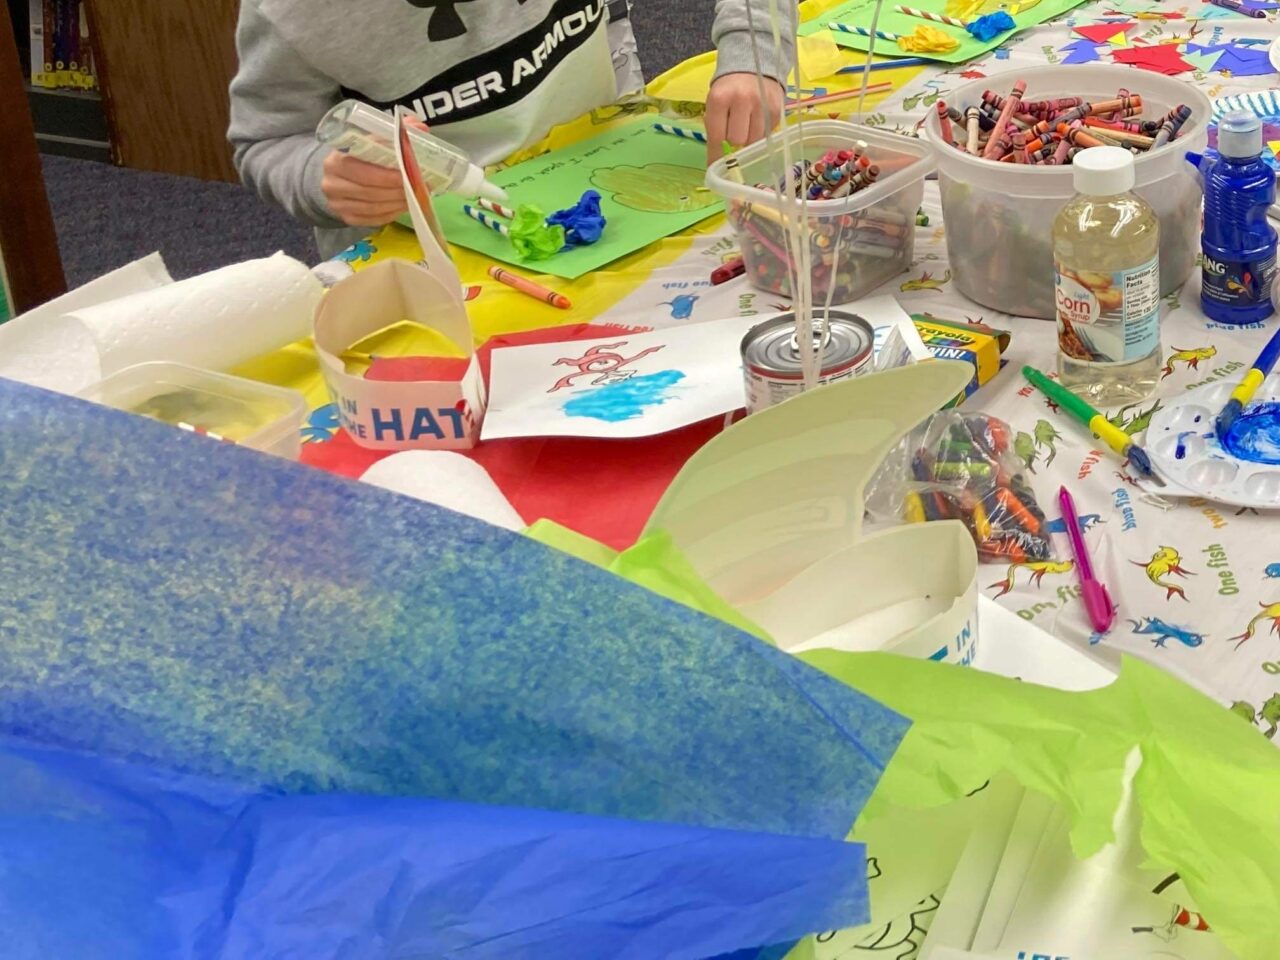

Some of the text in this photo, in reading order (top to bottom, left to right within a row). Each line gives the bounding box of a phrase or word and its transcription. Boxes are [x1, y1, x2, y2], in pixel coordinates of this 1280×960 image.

[1126, 270, 1151, 282] Nutrition
[1126, 280, 1143, 289] Facts
[1057, 288, 1091, 314] Corn
[1071, 310, 1090, 321] Syrup
[1210, 359, 1246, 378] fish
[342, 398, 359, 416] IN
[346, 407, 467, 442] HE HAT
[1111, 488, 1137, 532] blue fish
[1202, 543, 1240, 596] One fish
[1056, 583, 1083, 608] fis
[955, 623, 973, 651] IN
